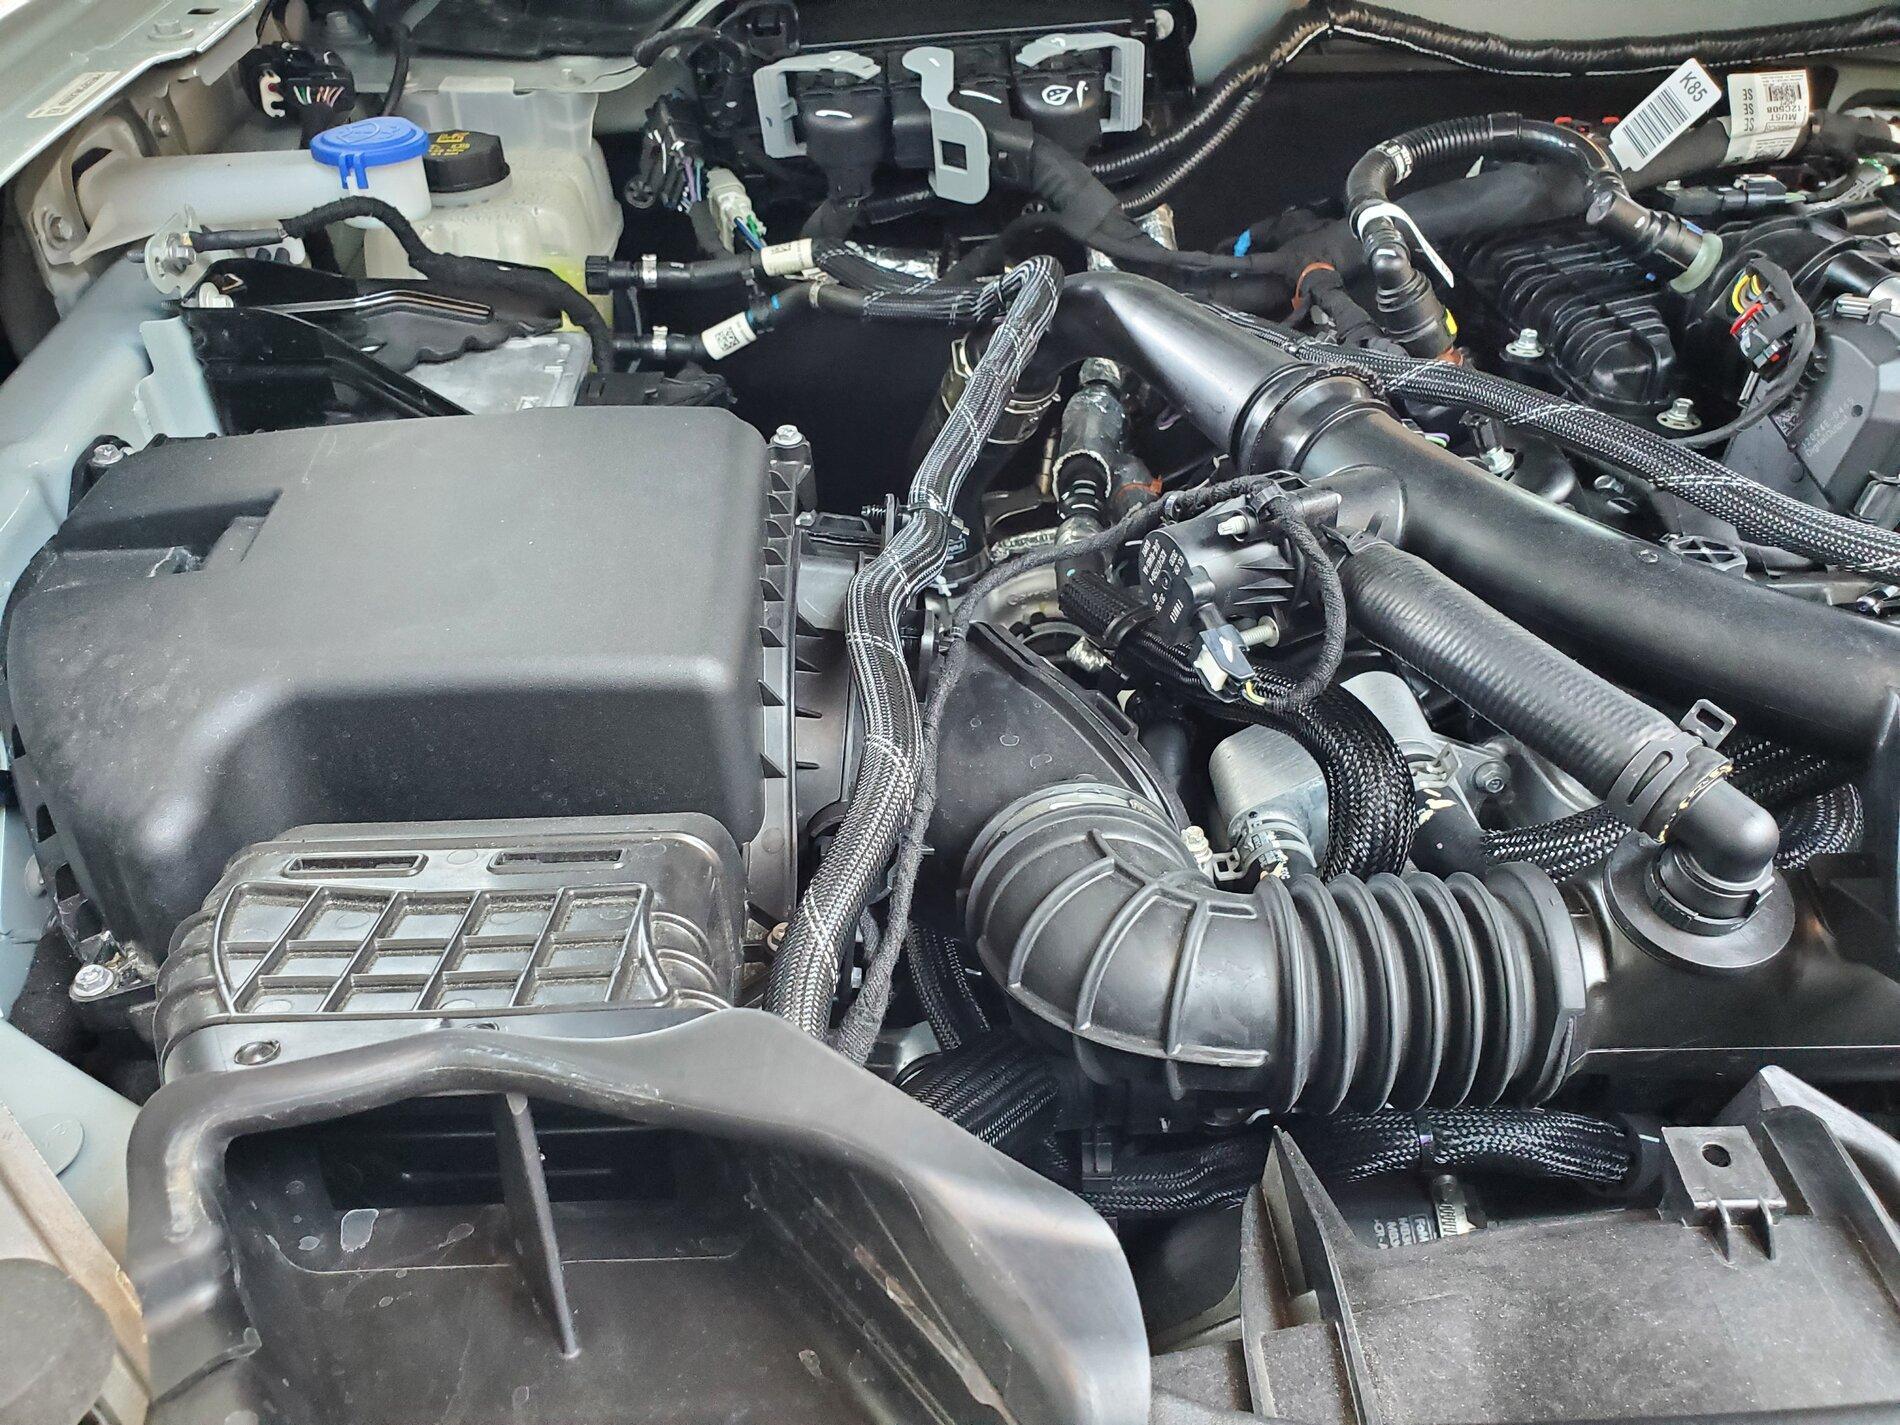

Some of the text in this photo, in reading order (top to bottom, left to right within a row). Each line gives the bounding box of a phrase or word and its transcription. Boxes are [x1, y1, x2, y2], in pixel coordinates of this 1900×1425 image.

[1680, 71, 1707, 102] K85
[1742, 88, 1754, 101] SE
[1743, 103, 1755, 115] SE
[1743, 117, 1755, 132] SE
